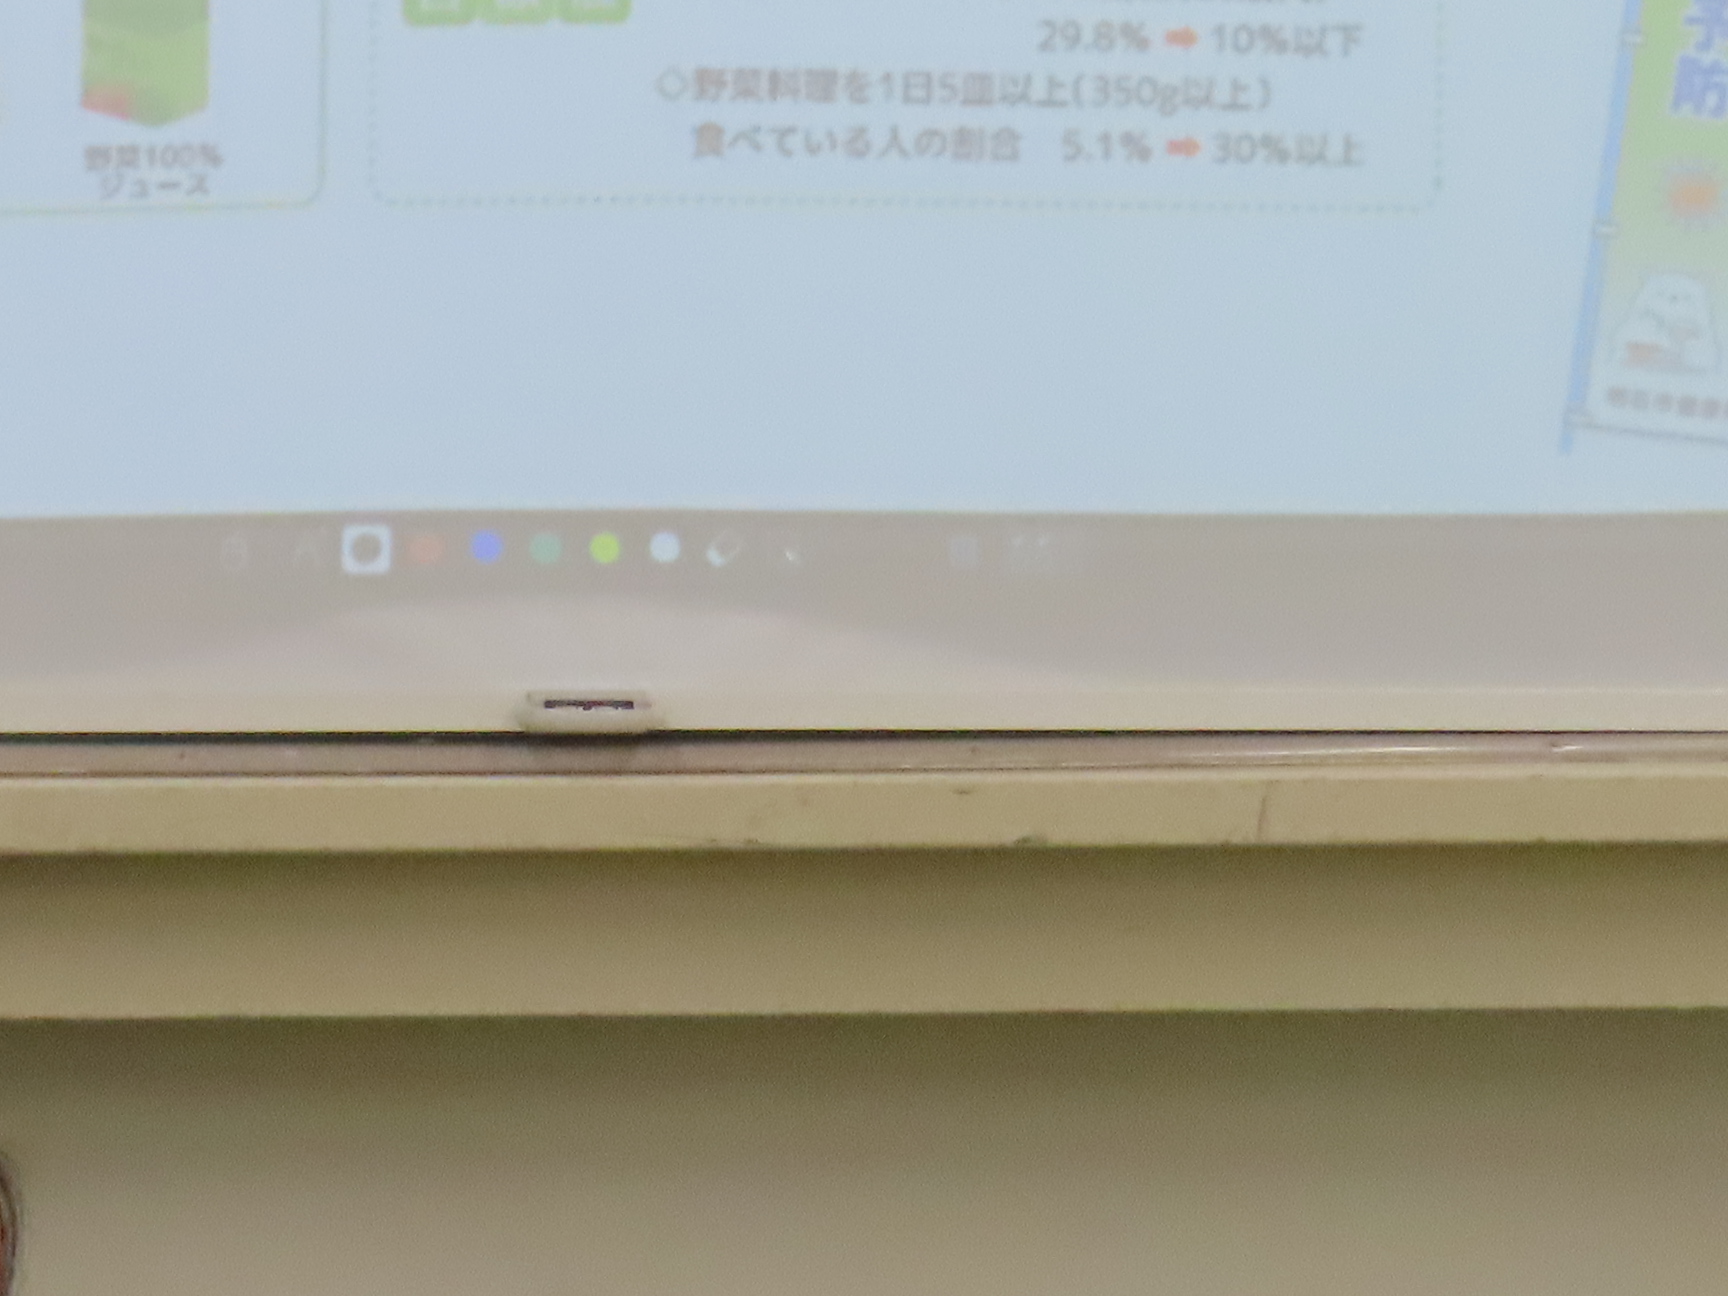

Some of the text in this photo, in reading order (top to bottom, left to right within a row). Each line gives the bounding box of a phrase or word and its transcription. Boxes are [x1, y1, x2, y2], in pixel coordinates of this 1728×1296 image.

[1035, 18, 1364, 58] 29.8% 10%以下
[692, 119, 1366, 169] 食べている人の割合 5.1% 30%以上
